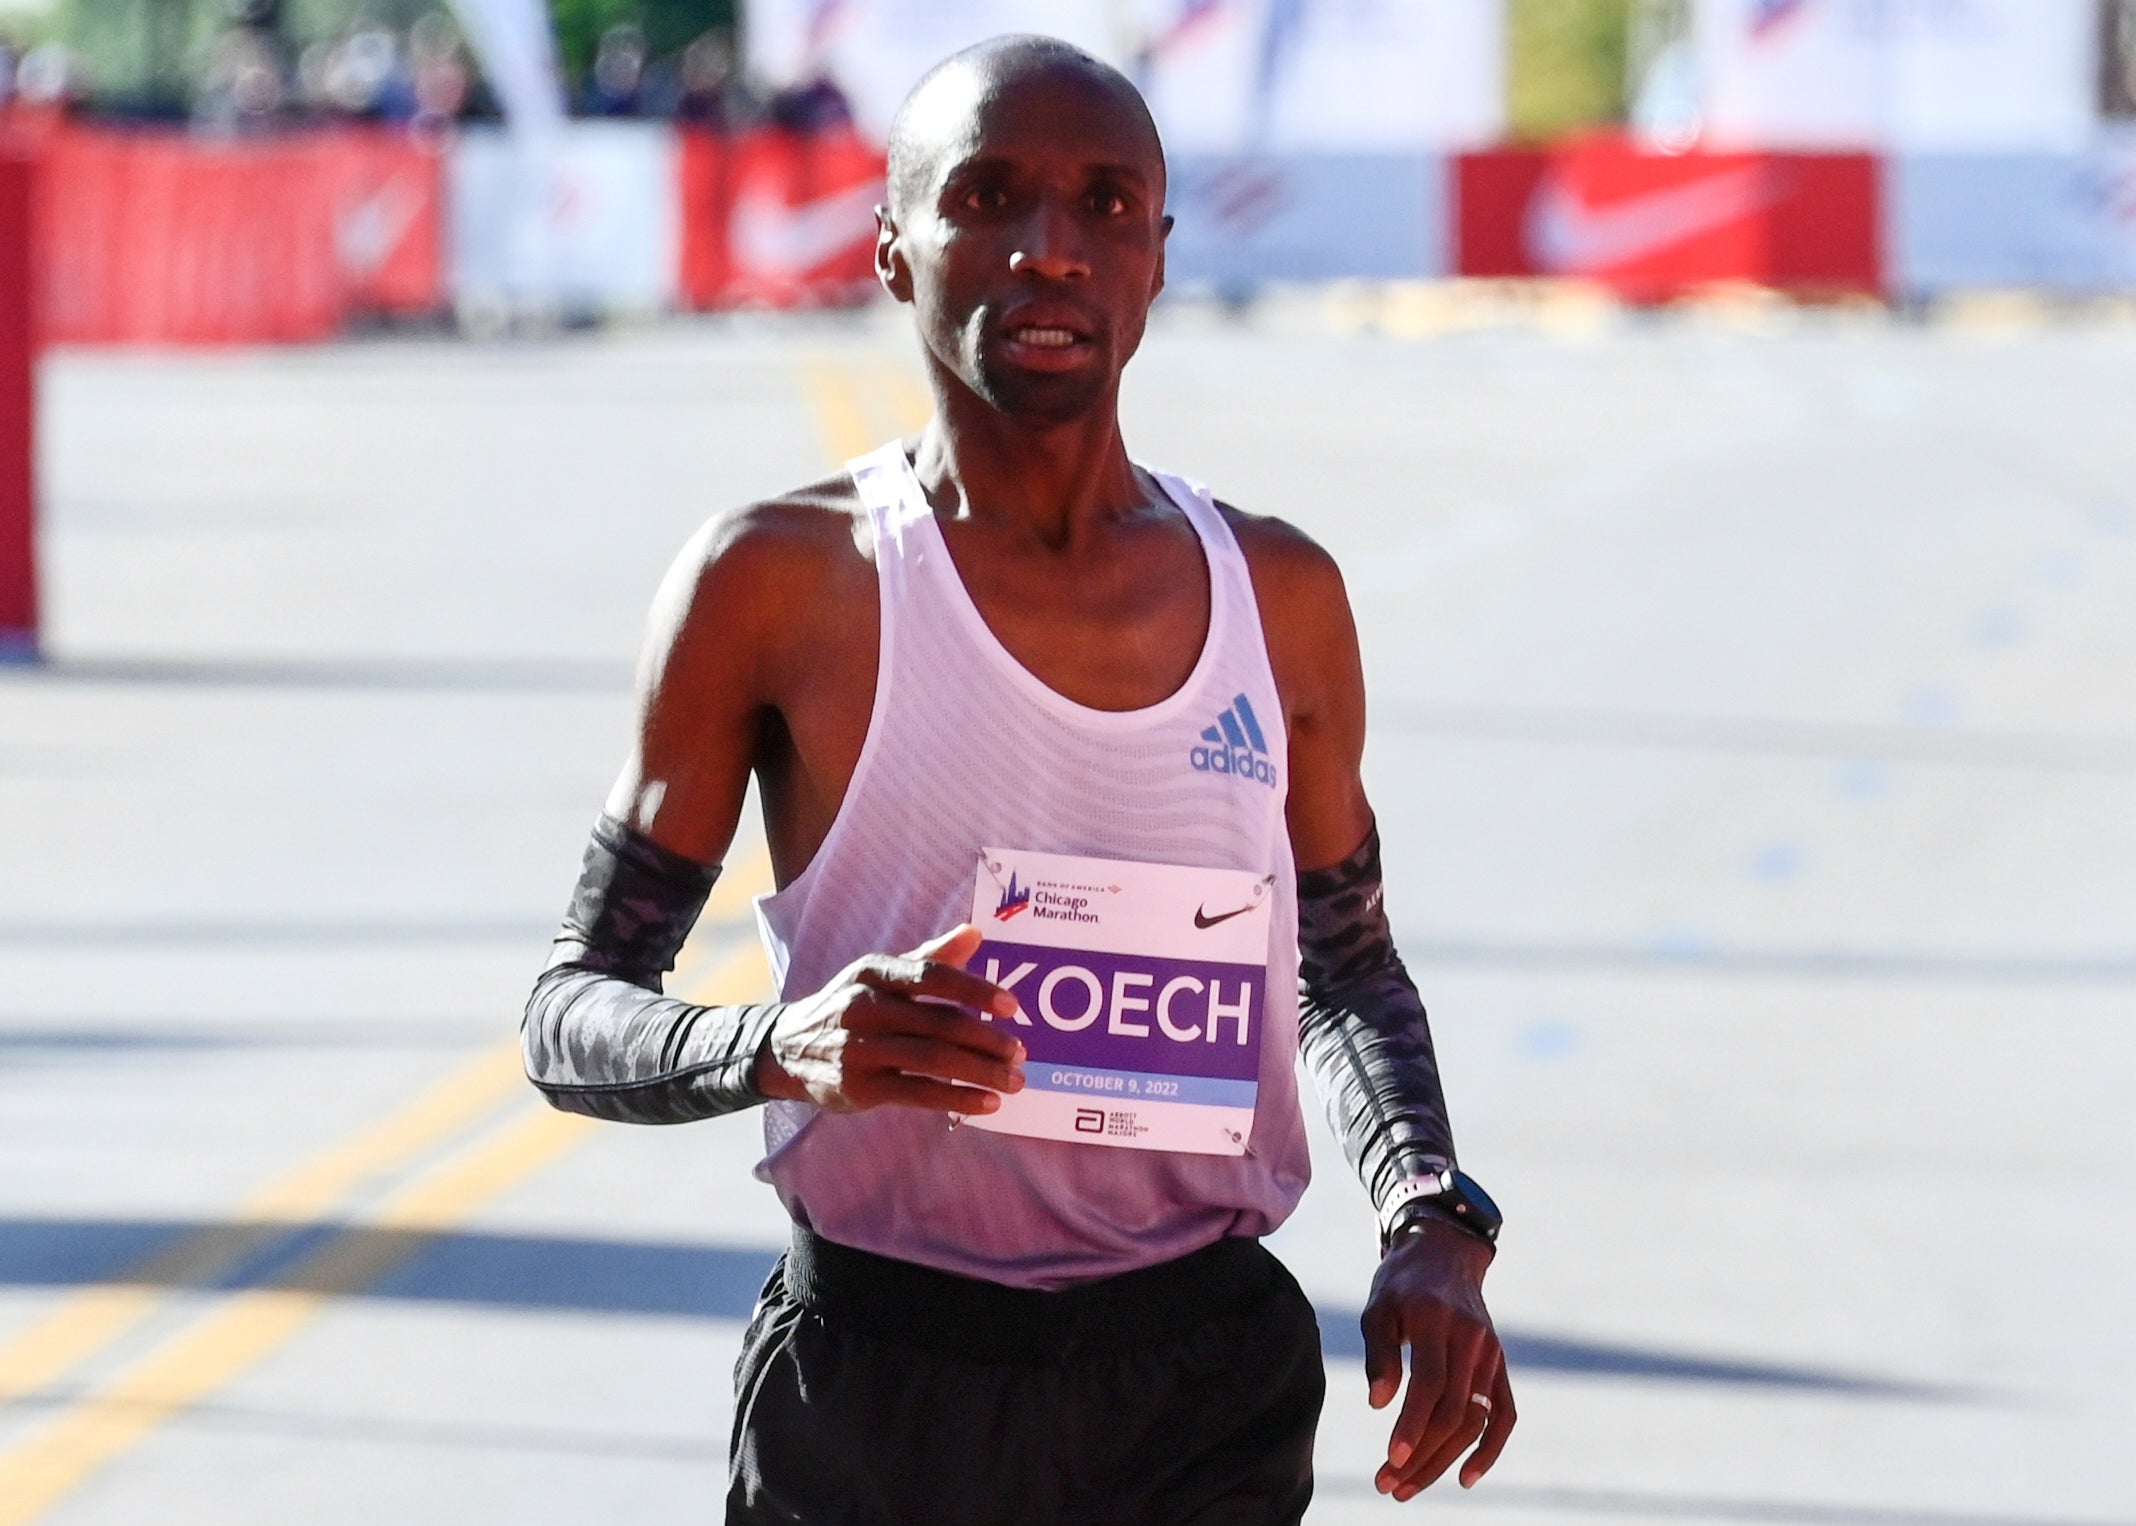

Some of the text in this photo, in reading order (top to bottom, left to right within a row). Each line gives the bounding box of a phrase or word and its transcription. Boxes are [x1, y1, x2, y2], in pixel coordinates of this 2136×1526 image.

[1190, 743, 1277, 790] adidas
[1035, 891, 1088, 910] Chicago
[1033, 906, 1099, 923] Marathon
[980, 958, 1252, 1046] KOECH
[1051, 1071, 1179, 1096] OCTOBER 9, 2022
